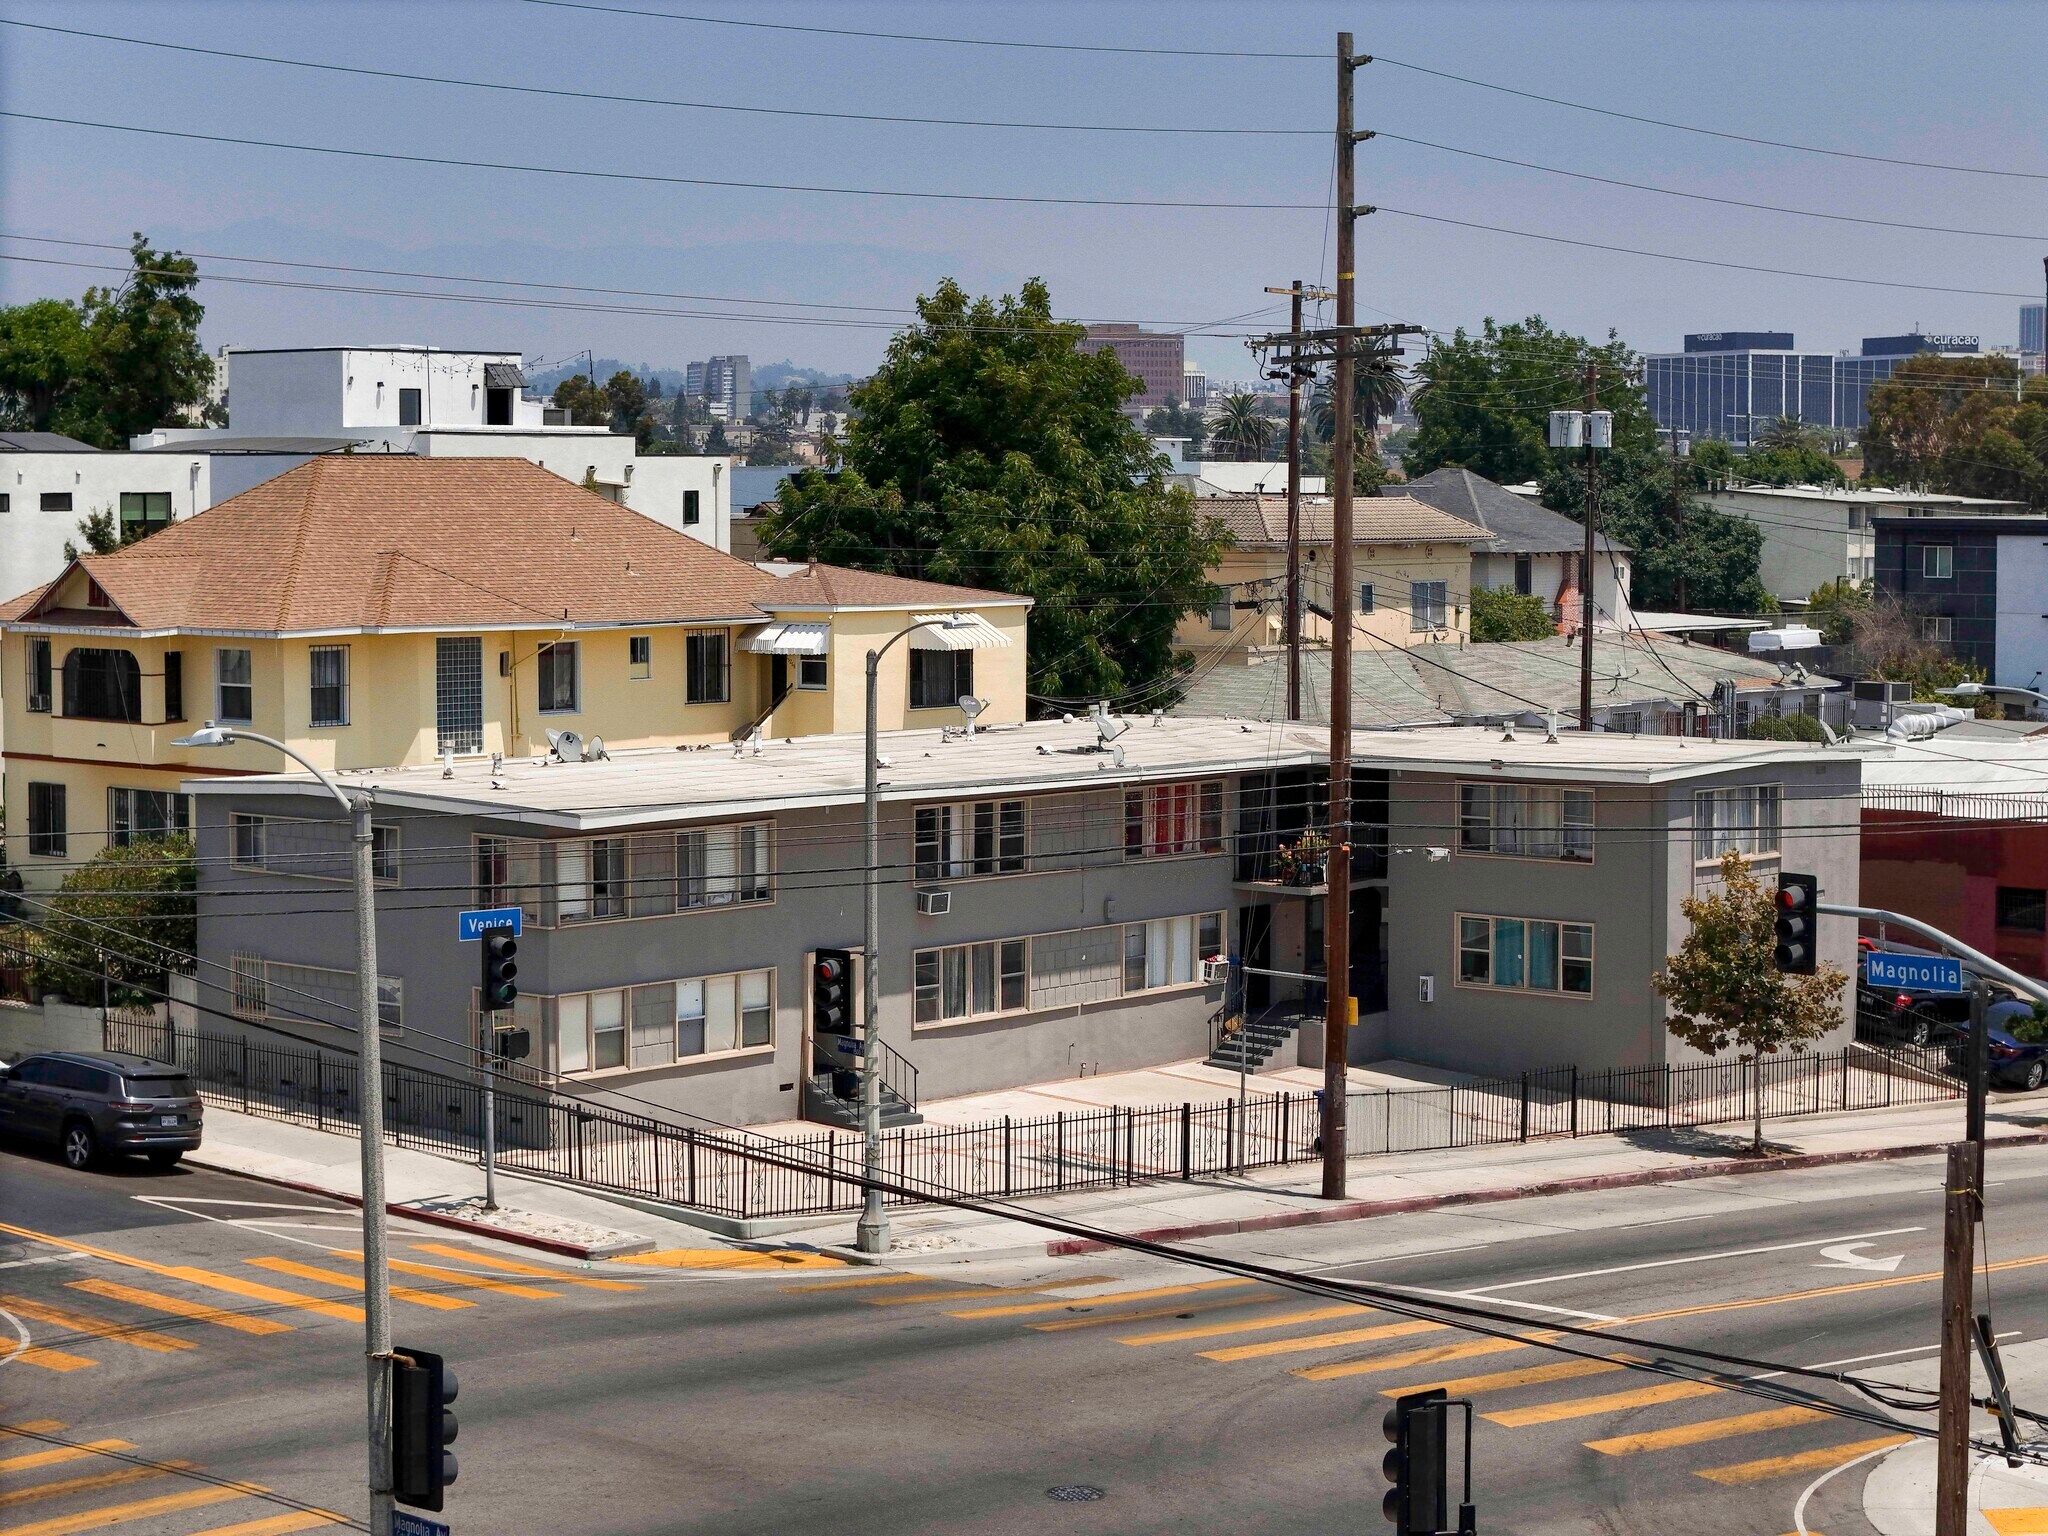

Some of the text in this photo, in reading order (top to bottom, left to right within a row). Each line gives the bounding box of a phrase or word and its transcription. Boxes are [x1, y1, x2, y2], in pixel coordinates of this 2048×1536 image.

[1933, 335, 1979, 345] curacao
[468, 918, 513, 932] Venice
[1871, 960, 1957, 985] Magnolia
[394, 1513, 430, 1536] Magnolia
